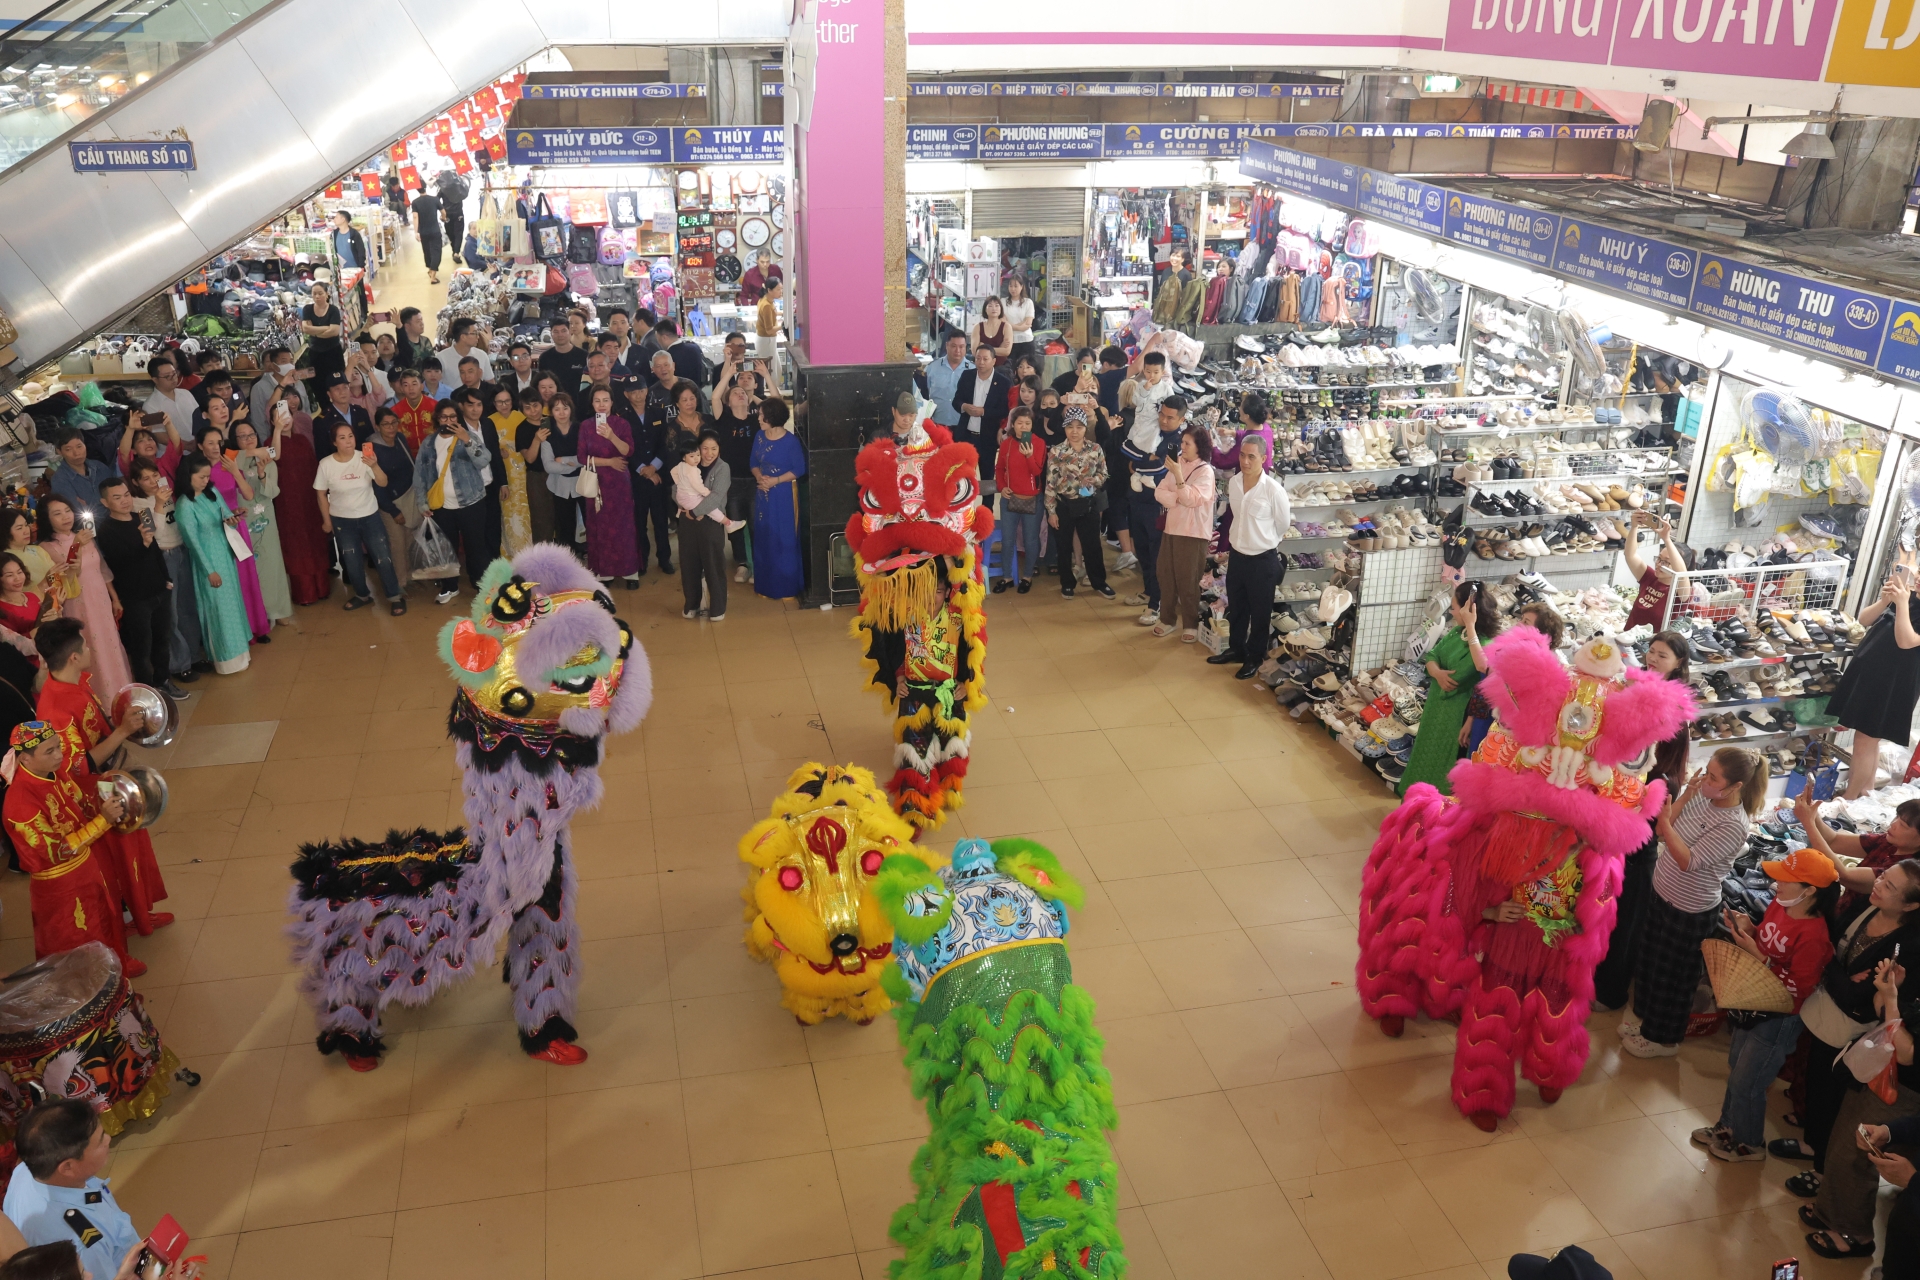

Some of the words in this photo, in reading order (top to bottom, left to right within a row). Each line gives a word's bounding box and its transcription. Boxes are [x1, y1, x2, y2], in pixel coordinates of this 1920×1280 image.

[591, 87, 638, 97] CHINH
[916, 86, 940, 95] LINH
[946, 86, 967, 95] QUY
[1006, 84, 1026, 96] HIỆP
[1114, 85, 1140, 95] NHUNG
[1292, 85, 1312, 96] HÀ
[543, 130, 585, 146] THỦY
[590, 129, 624, 145] ĐỨC
[913, 129, 947, 141] CHINH
[1000, 126, 1047, 140] PHƯƠNG
[1048, 127, 1089, 140] NHUNG
[1160, 124, 1230, 139] CƯỜNG
[1574, 126, 1613, 140] TUYẾT
[995, 142, 1015, 150] BUÔN
[1047, 141, 1061, 150] DÉP
[1061, 141, 1076, 149] CÁC
[78, 146, 104, 165] CẦU
[106, 150, 149, 164] THANG
[152, 145, 169, 164] SỐ
[172, 149, 187, 164] 10
[1274, 149, 1301, 167] PHƯƠNG
[1302, 156, 1317, 170] ANH
[1339, 182, 1349, 192] em
[1463, 202, 1505, 227] PHƯƠNG
[1507, 213, 1531, 234] NGA
[1599, 236, 1635, 260] NHƯ
[1637, 243, 1649, 265] Ý
[1579, 253, 1590, 265] Bán
[1625, 267, 1638, 280] dép
[1638, 270, 1650, 283] các
[1650, 273, 1664, 287] loại
[1668, 257, 1689, 273] 336-A1
[1730, 268, 1781, 304] HÙNG
[1797, 286, 1835, 317] THU
[1722, 295, 1737, 309] Bán
[1737, 299, 1758, 316] buôn,
[1785, 313, 1800, 328] dép
[1801, 318, 1817, 332] các
[1818, 322, 1836, 339] loại
[1848, 304, 1876, 324] 338-A1
[1895, 364, 1905, 374] ĐT
